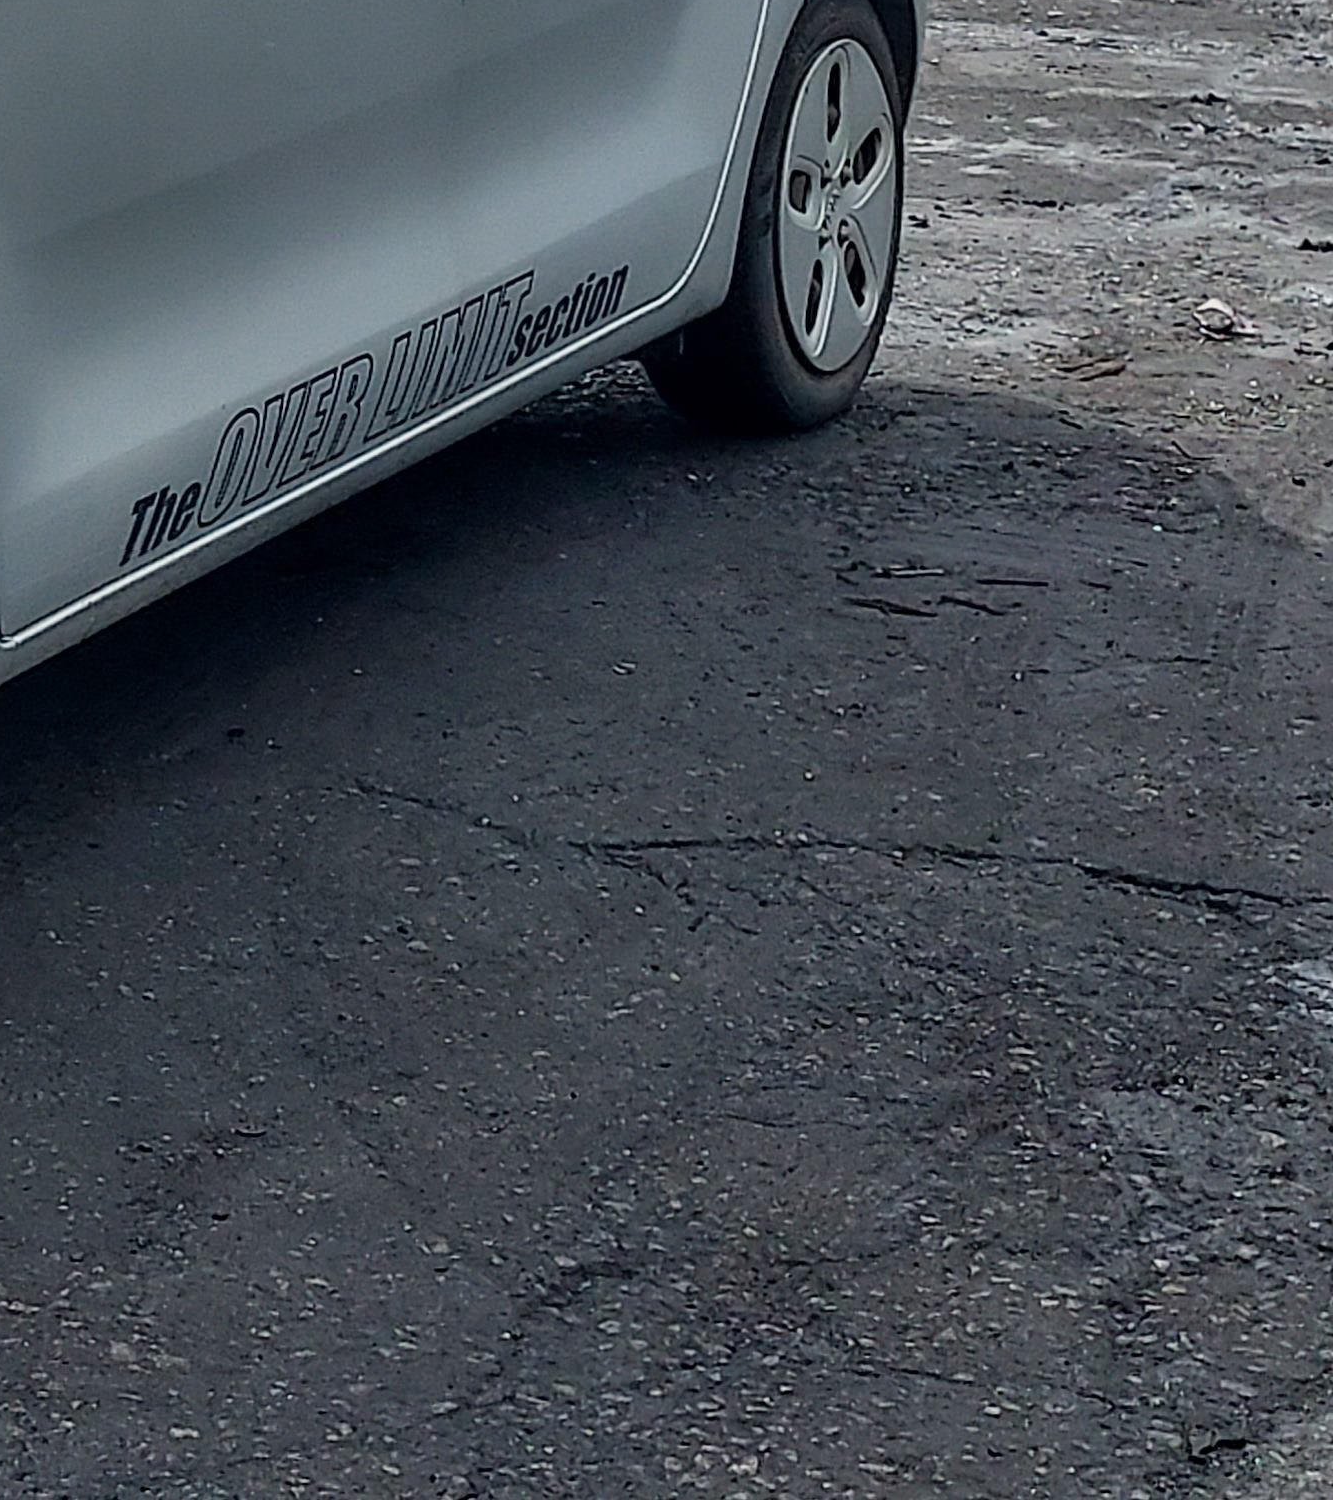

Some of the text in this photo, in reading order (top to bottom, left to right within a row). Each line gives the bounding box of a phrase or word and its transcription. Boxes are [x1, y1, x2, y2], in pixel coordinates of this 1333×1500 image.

[120, 265, 629, 566] The OVER LIMIT section
